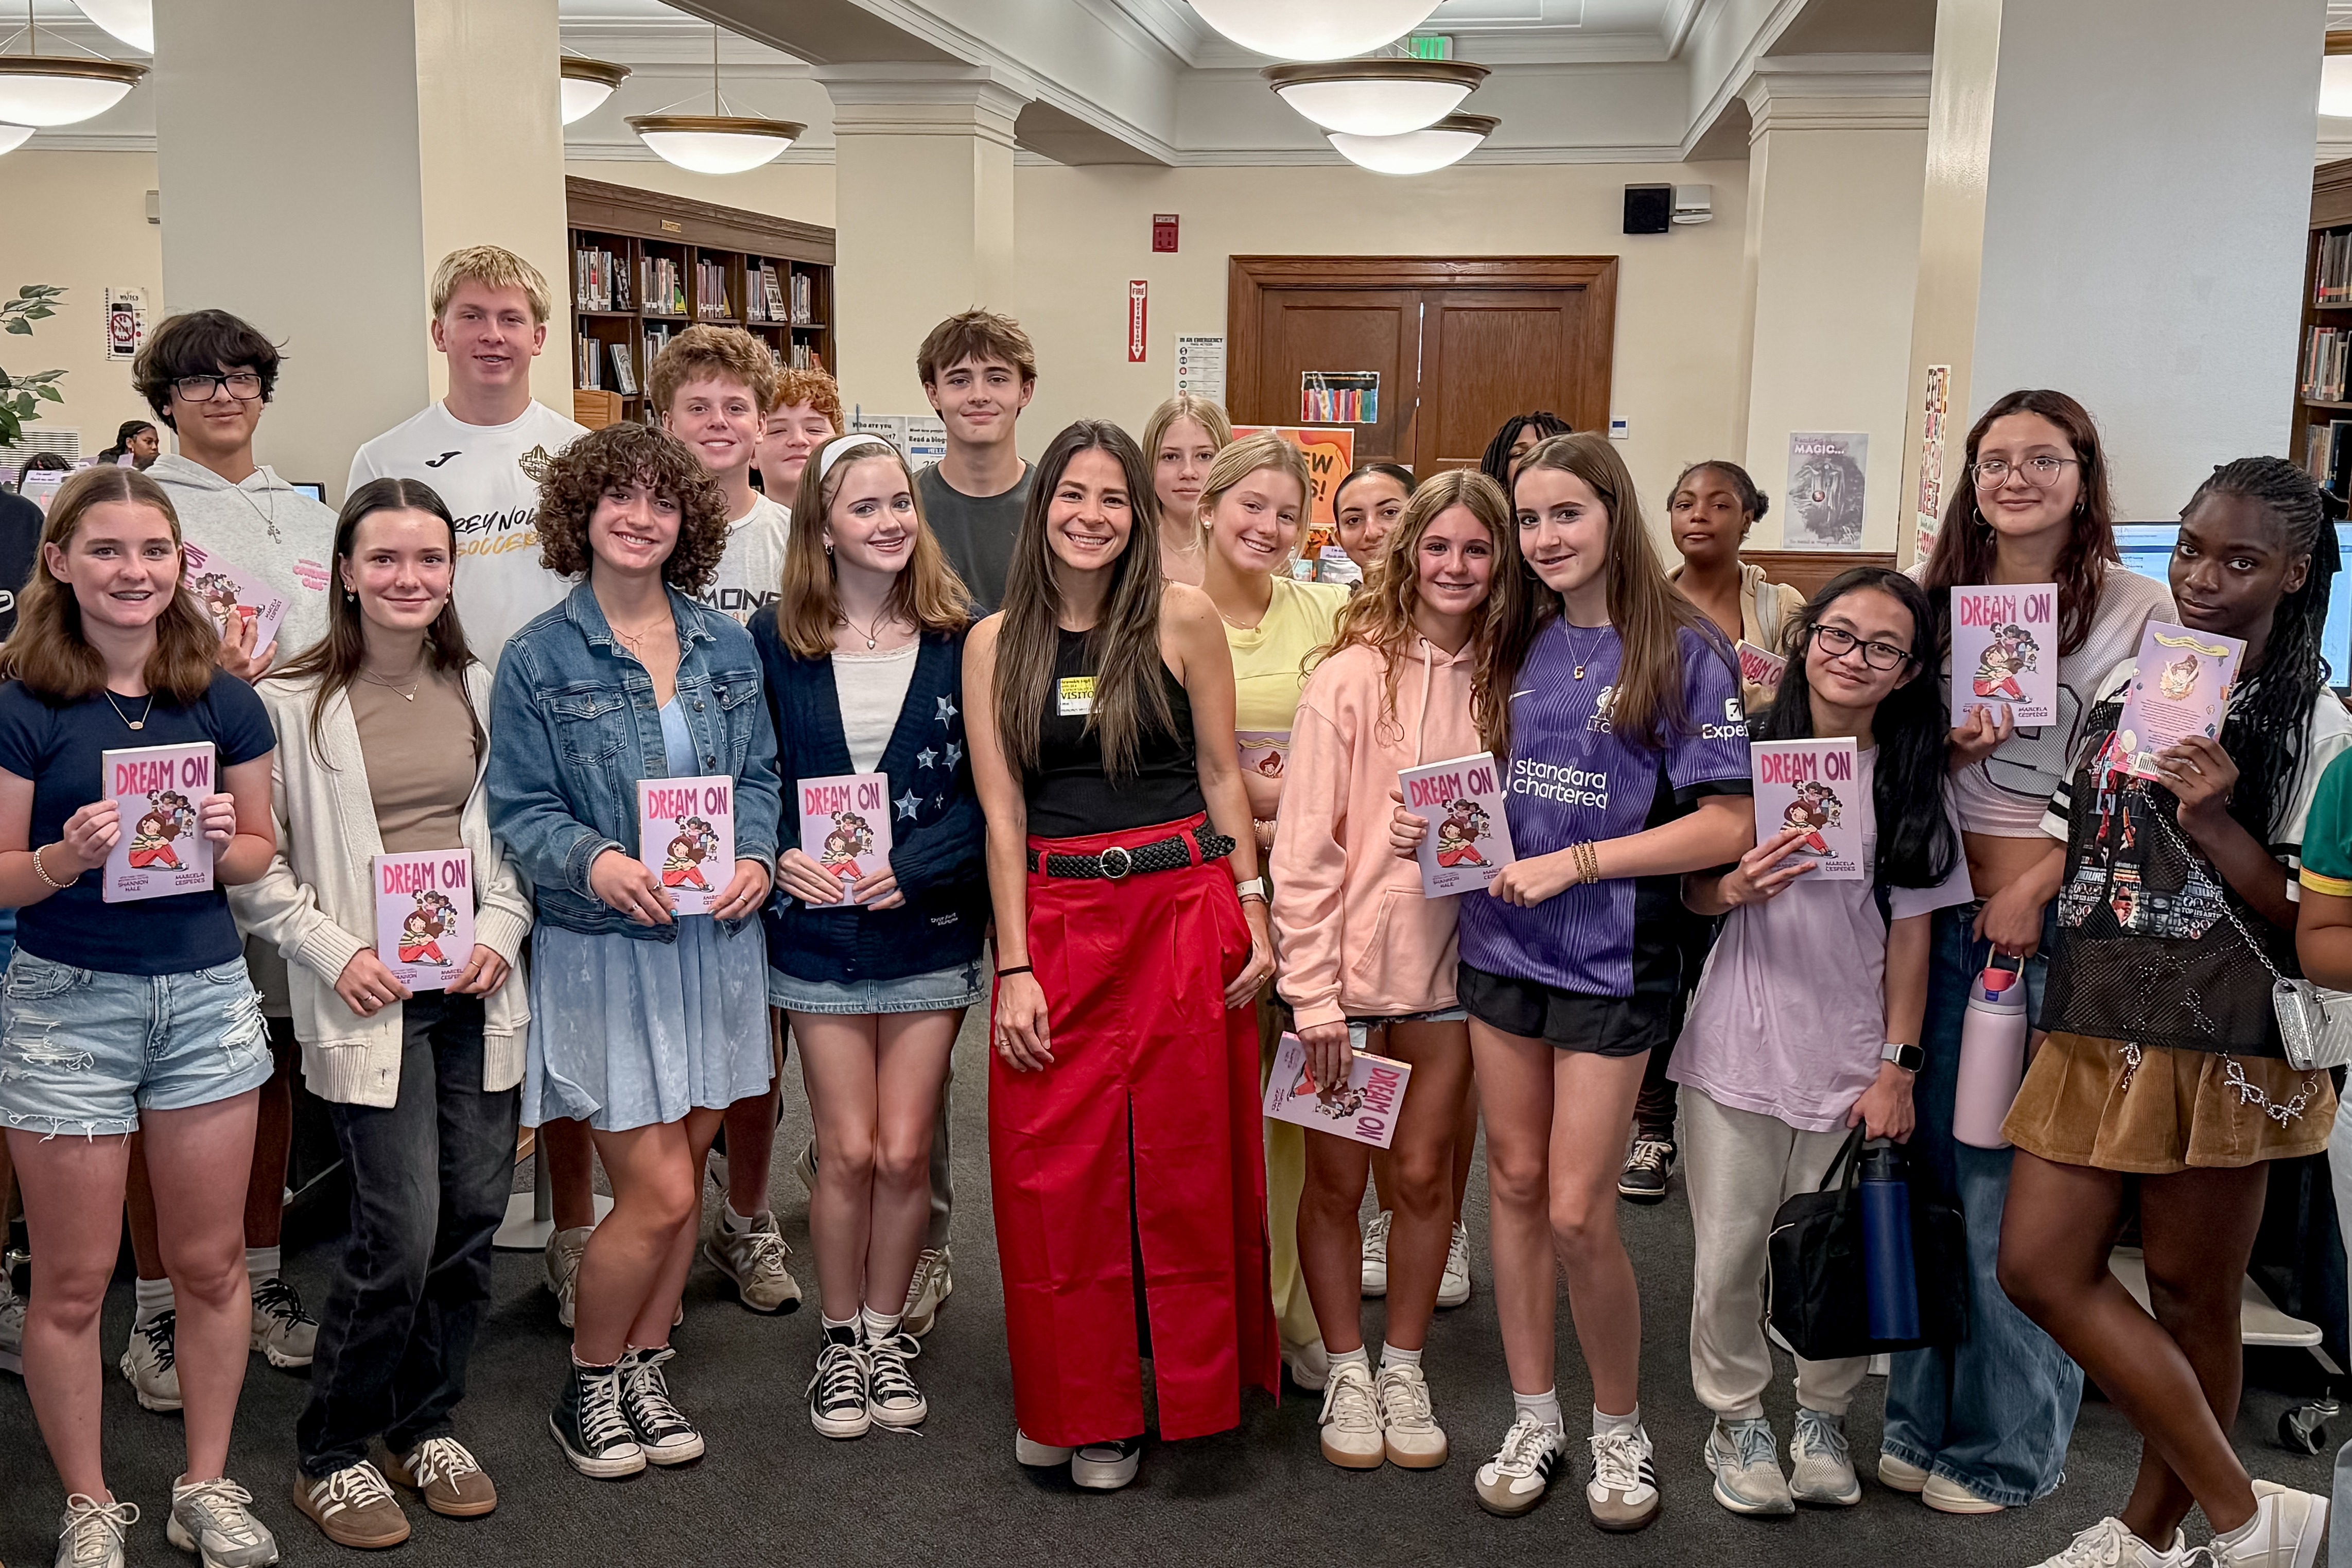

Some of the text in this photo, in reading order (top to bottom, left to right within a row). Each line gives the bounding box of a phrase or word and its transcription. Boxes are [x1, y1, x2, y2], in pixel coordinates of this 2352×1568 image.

[455, 506, 536, 535] REYNOL
[1961, 594, 2051, 626] DREAM ON
[1060, 690, 1094, 699] VISITO
[116, 756, 208, 796] DREAM ON
[1514, 757, 1607, 790] standard
[1761, 751, 1852, 784] DREAM ON
[648, 787, 727, 820] DREAM ON
[805, 782, 880, 815] DREAM ON
[1409, 766, 1494, 808] DREAM ON
[1513, 778, 1609, 810] chartered
[382, 859, 466, 894] DREAM ON
[1363, 1067, 1401, 1115] DREAM
[1355, 1116, 1385, 1141] ON
